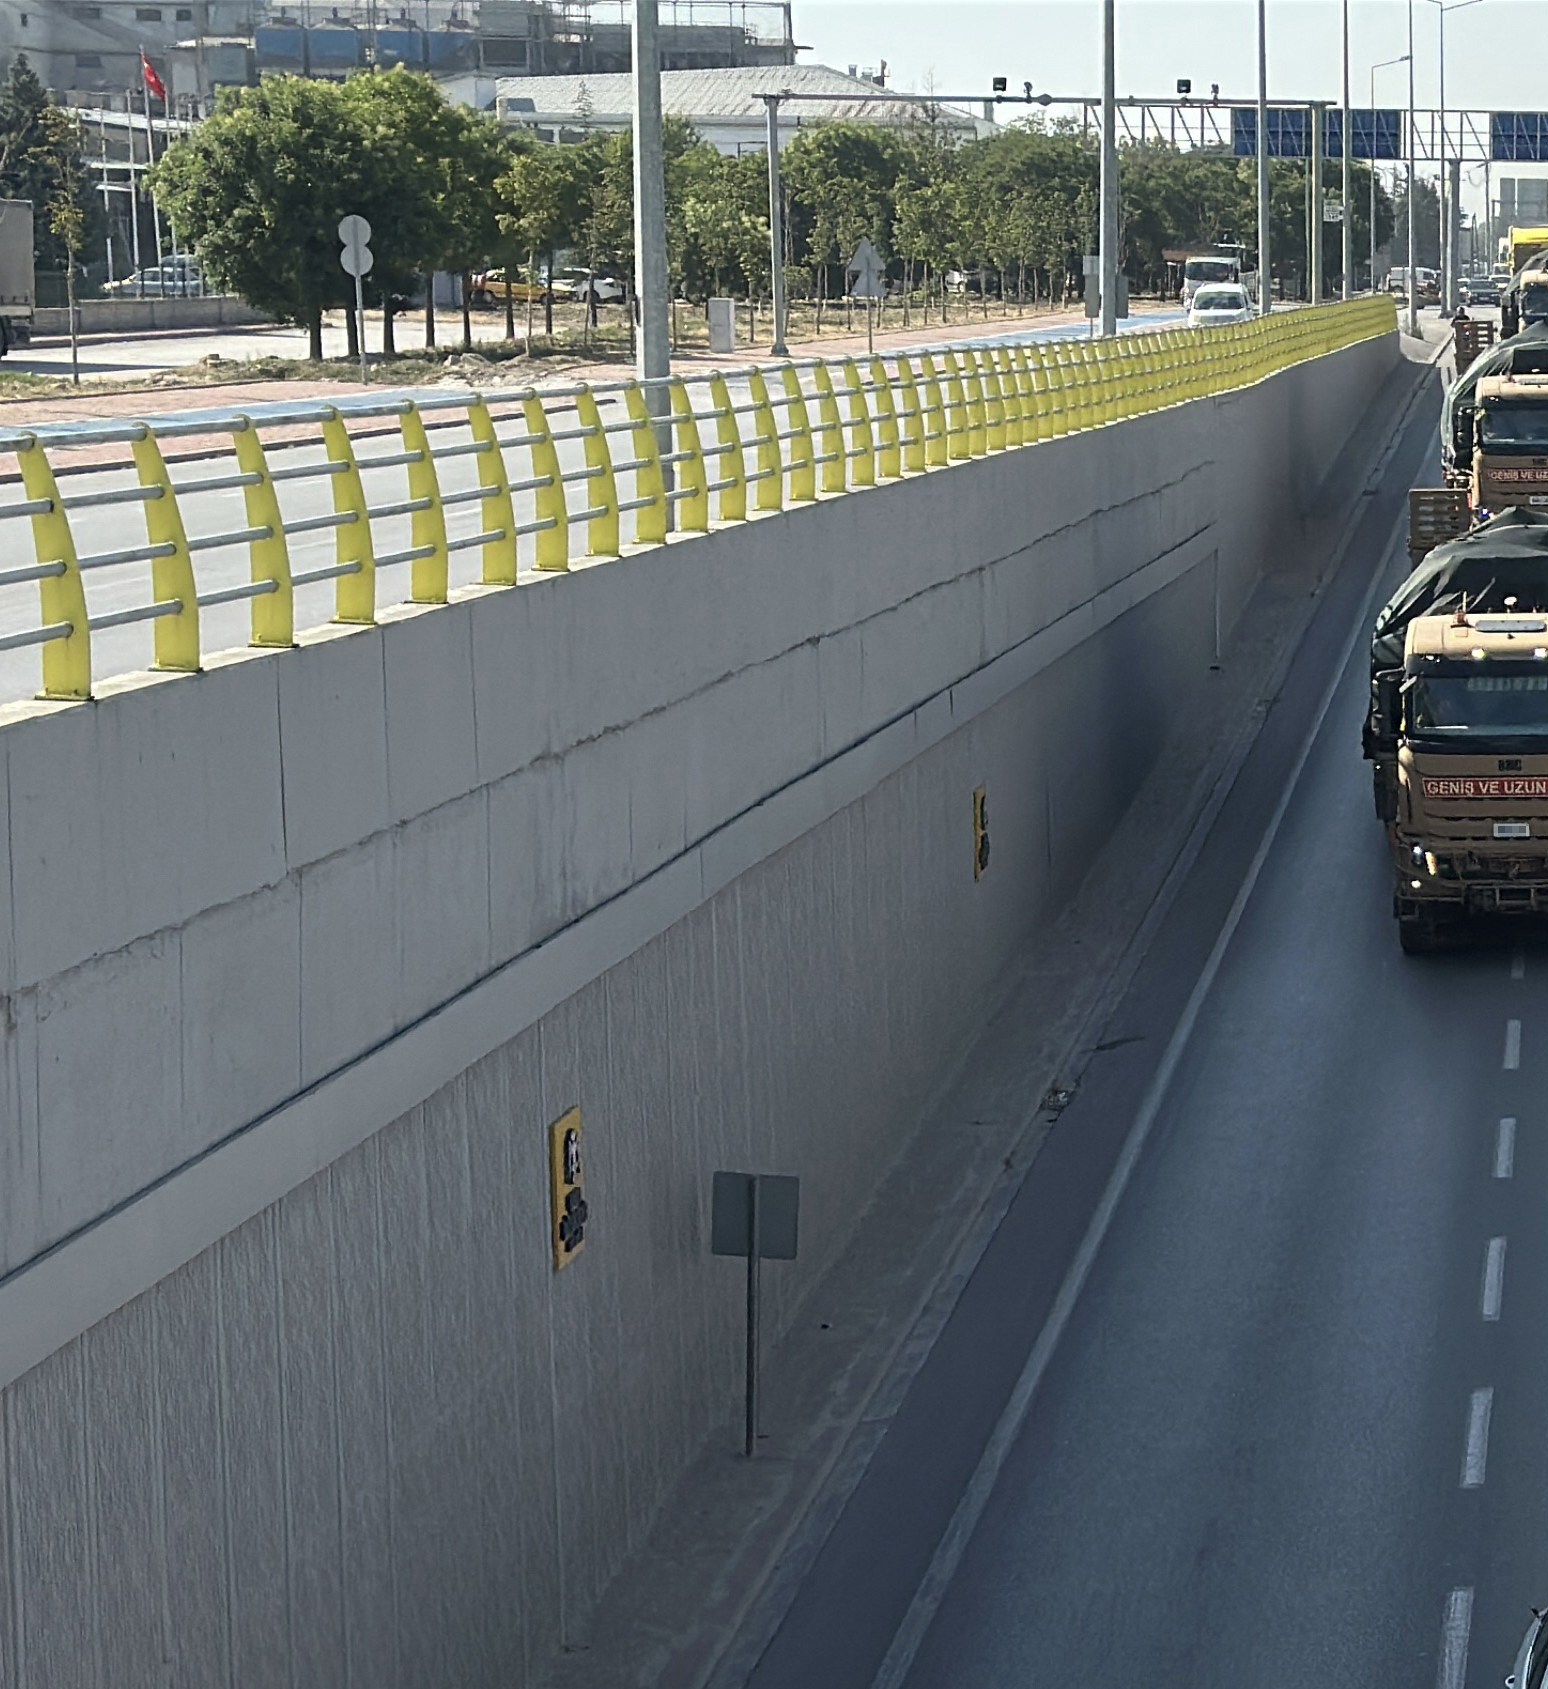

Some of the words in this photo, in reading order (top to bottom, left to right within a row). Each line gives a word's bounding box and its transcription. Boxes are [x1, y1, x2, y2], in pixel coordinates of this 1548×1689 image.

[1427, 778, 1475, 796] GENİŞ
[1479, 781, 1499, 794] VE
[1504, 780, 1546, 794] UZUN
